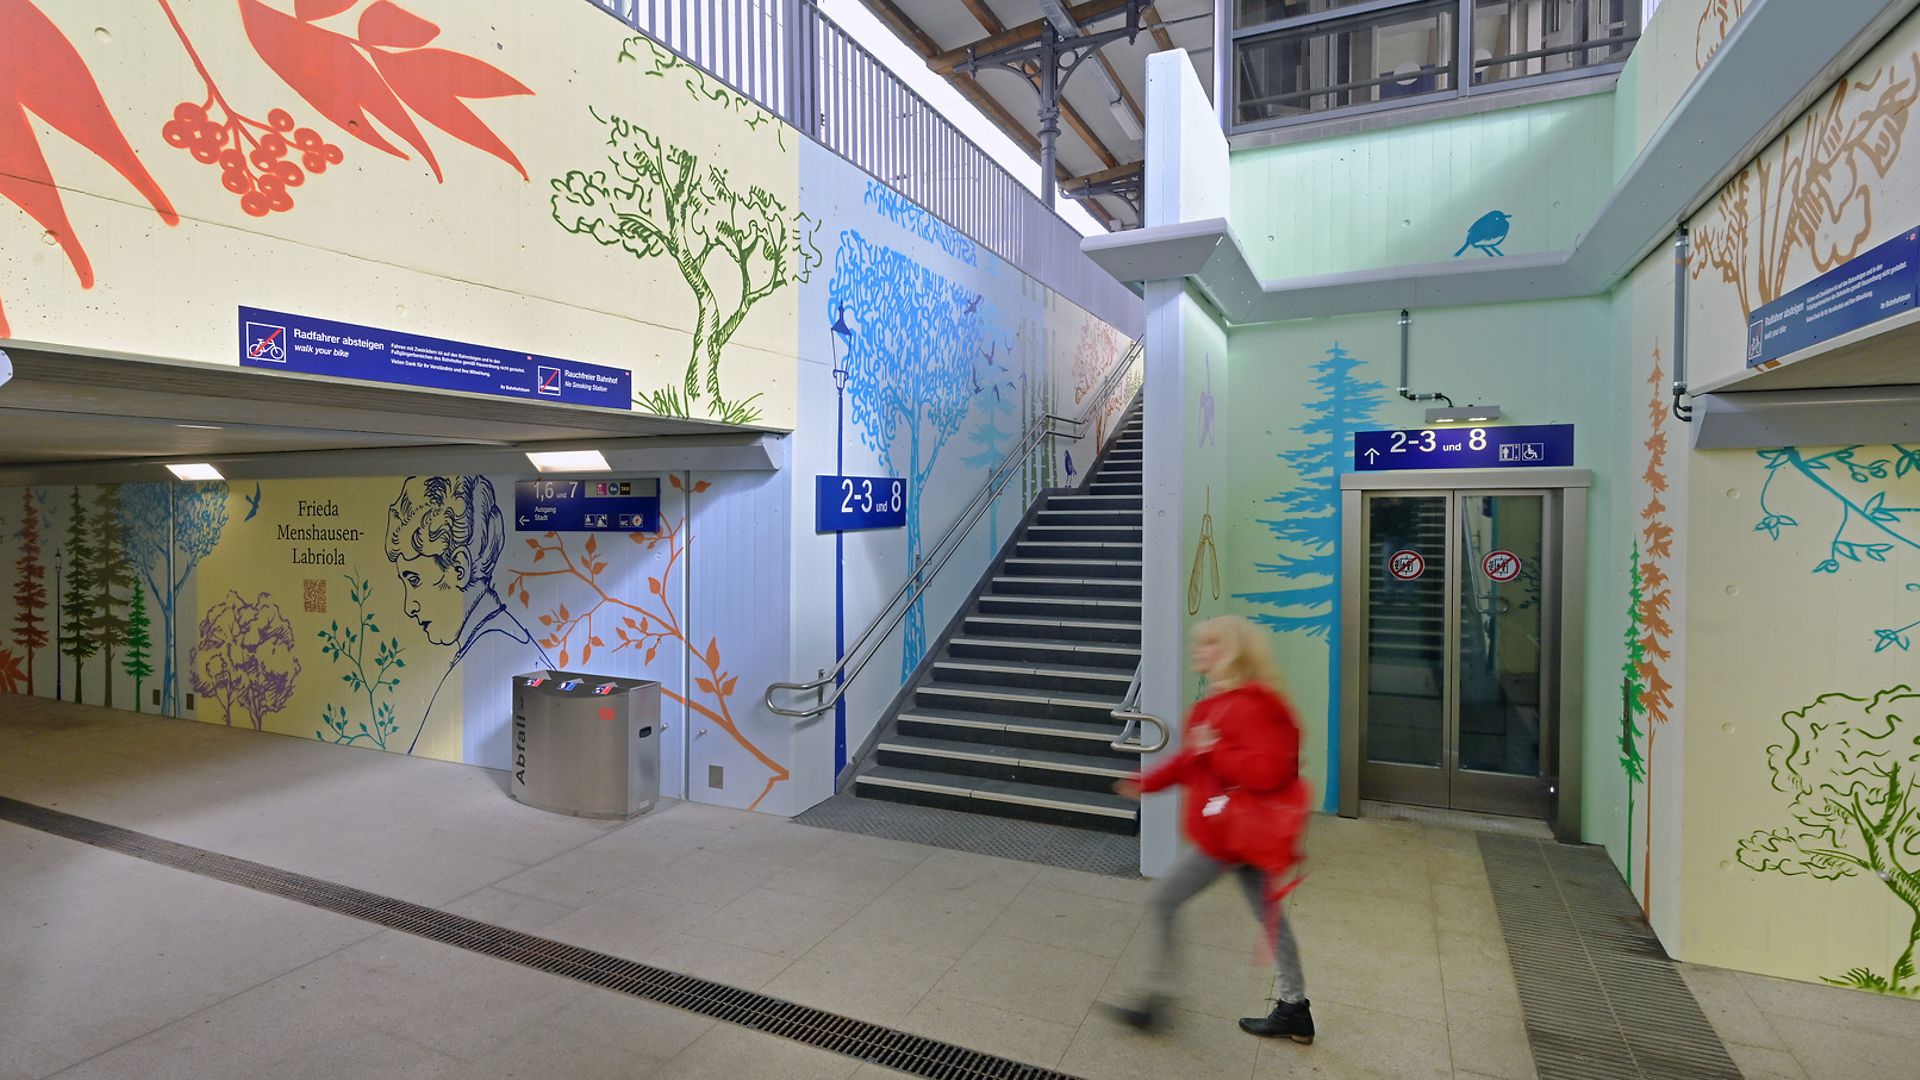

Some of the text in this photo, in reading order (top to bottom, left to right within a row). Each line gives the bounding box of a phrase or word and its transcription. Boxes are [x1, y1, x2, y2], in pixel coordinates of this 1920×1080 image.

[293, 328, 384, 351] Radfahrer absteigen
[294, 343, 349, 357] walk your bike
[564, 369, 618, 383] Rauchfreier Bahnhof
[572, 381, 592, 390] Smoking
[592, 383, 608, 391] Station
[1390, 428, 1487, 452] 2-3 und 8
[534, 482, 554, 501] 1,6
[569, 482, 578, 498] 7
[841, 478, 901, 512] 2-3 und 8
[298, 500, 339, 516] Frieda
[535, 506, 556, 514] Ausgang
[277, 524, 364, 541] Menshausen-
[292, 548, 345, 565] Labriola
